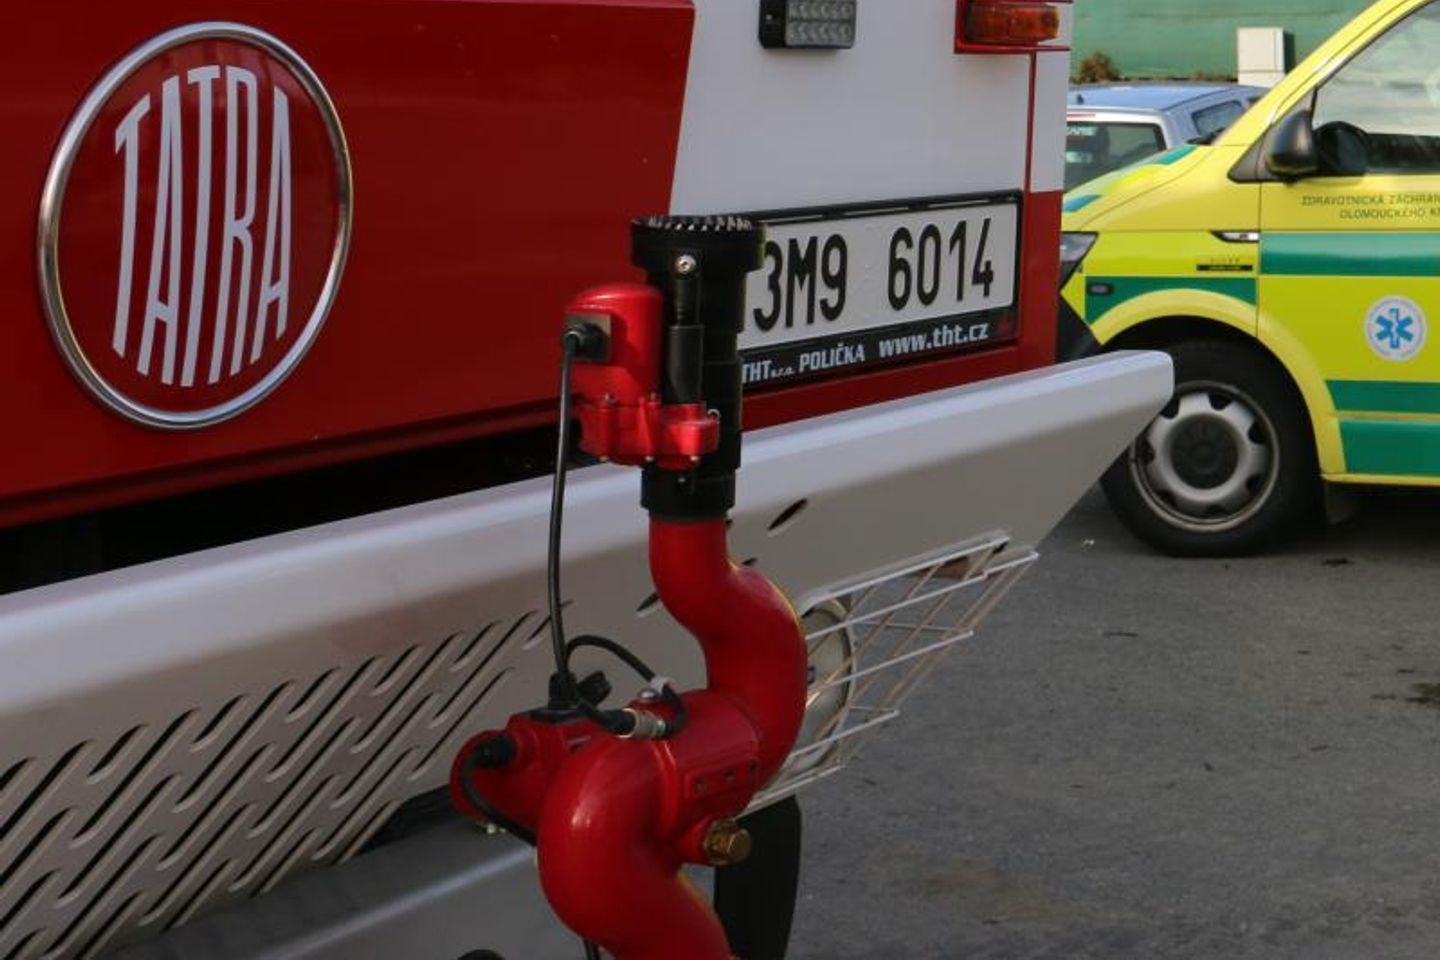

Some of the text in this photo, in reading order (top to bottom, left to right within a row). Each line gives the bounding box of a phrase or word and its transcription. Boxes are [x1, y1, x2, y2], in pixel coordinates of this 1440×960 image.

[112, 64, 292, 388] TATRA
[752, 217, 995, 333] 3M9 6014
[799, 342, 866, 373] POLIČKA
[878, 322, 990, 358] www.tht.cz
